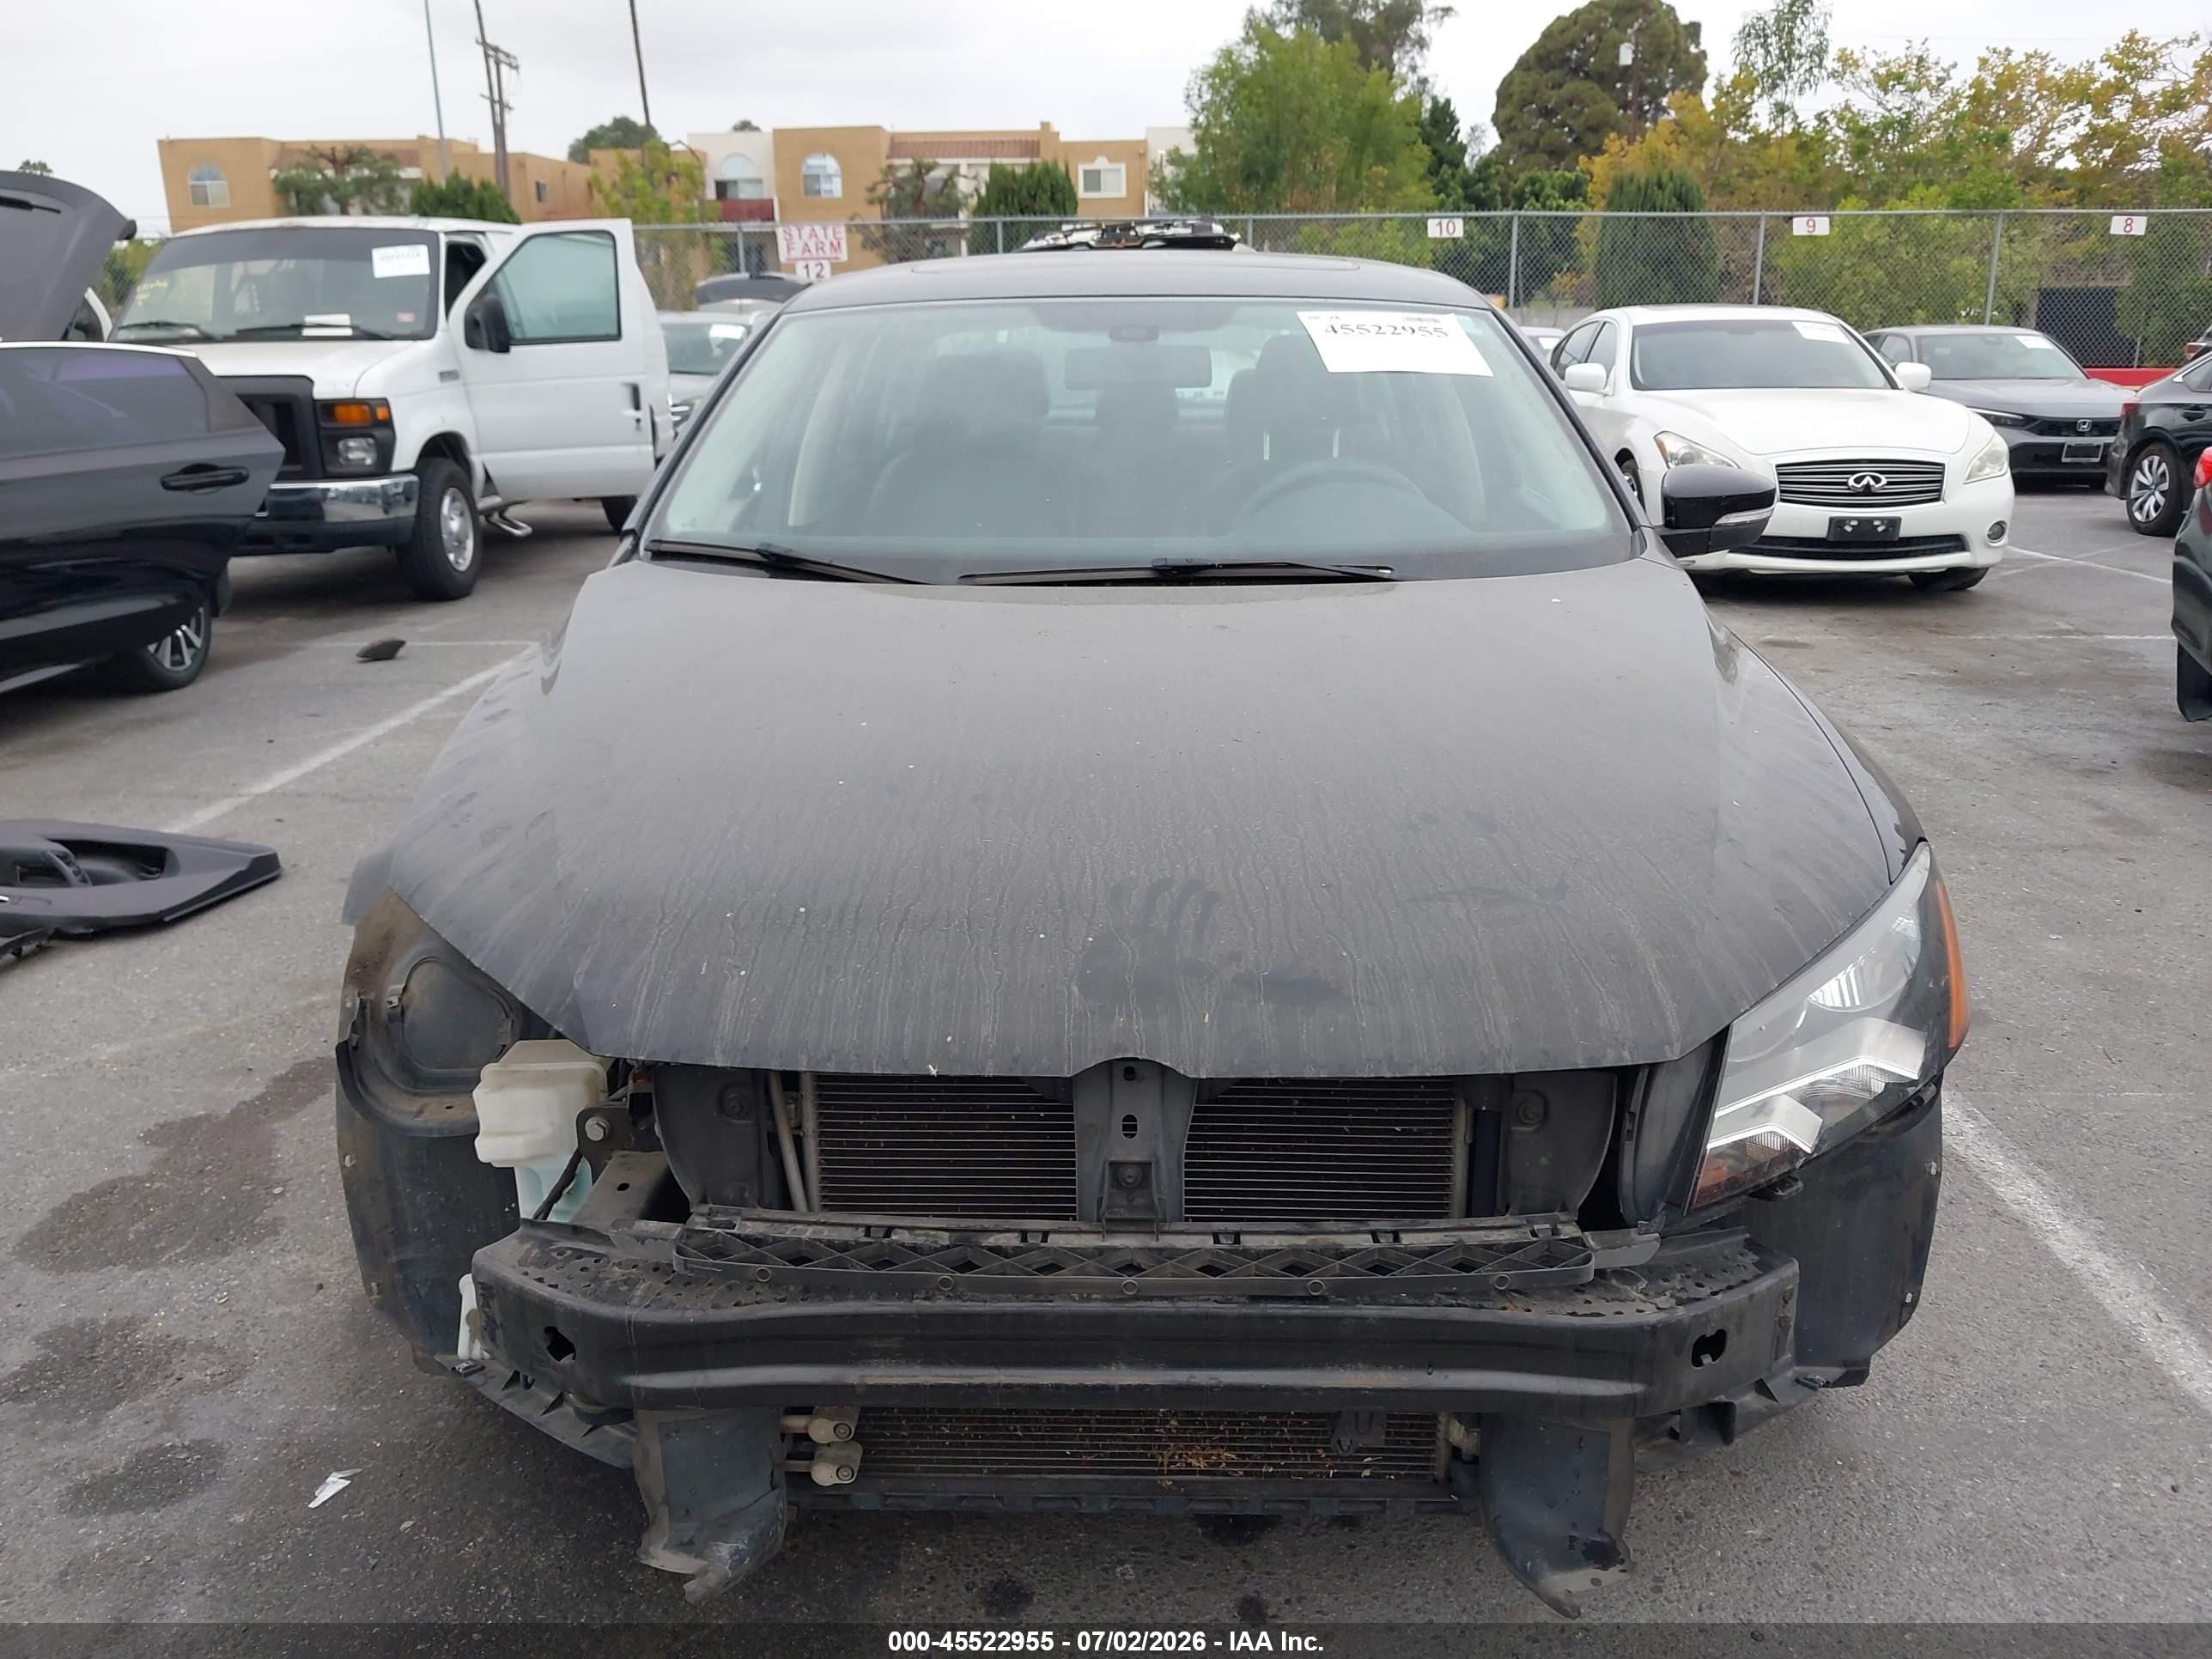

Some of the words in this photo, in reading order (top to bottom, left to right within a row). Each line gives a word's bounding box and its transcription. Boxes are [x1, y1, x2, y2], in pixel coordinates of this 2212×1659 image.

[782, 225, 843, 240] STATE
[1435, 219, 1456, 236] 10
[1806, 218, 1816, 234] 9
[2123, 217, 2134, 234] 8
[786, 240, 842, 255] FARM
[804, 262, 825, 279] 12
[1325, 324, 1449, 337] 45522955
